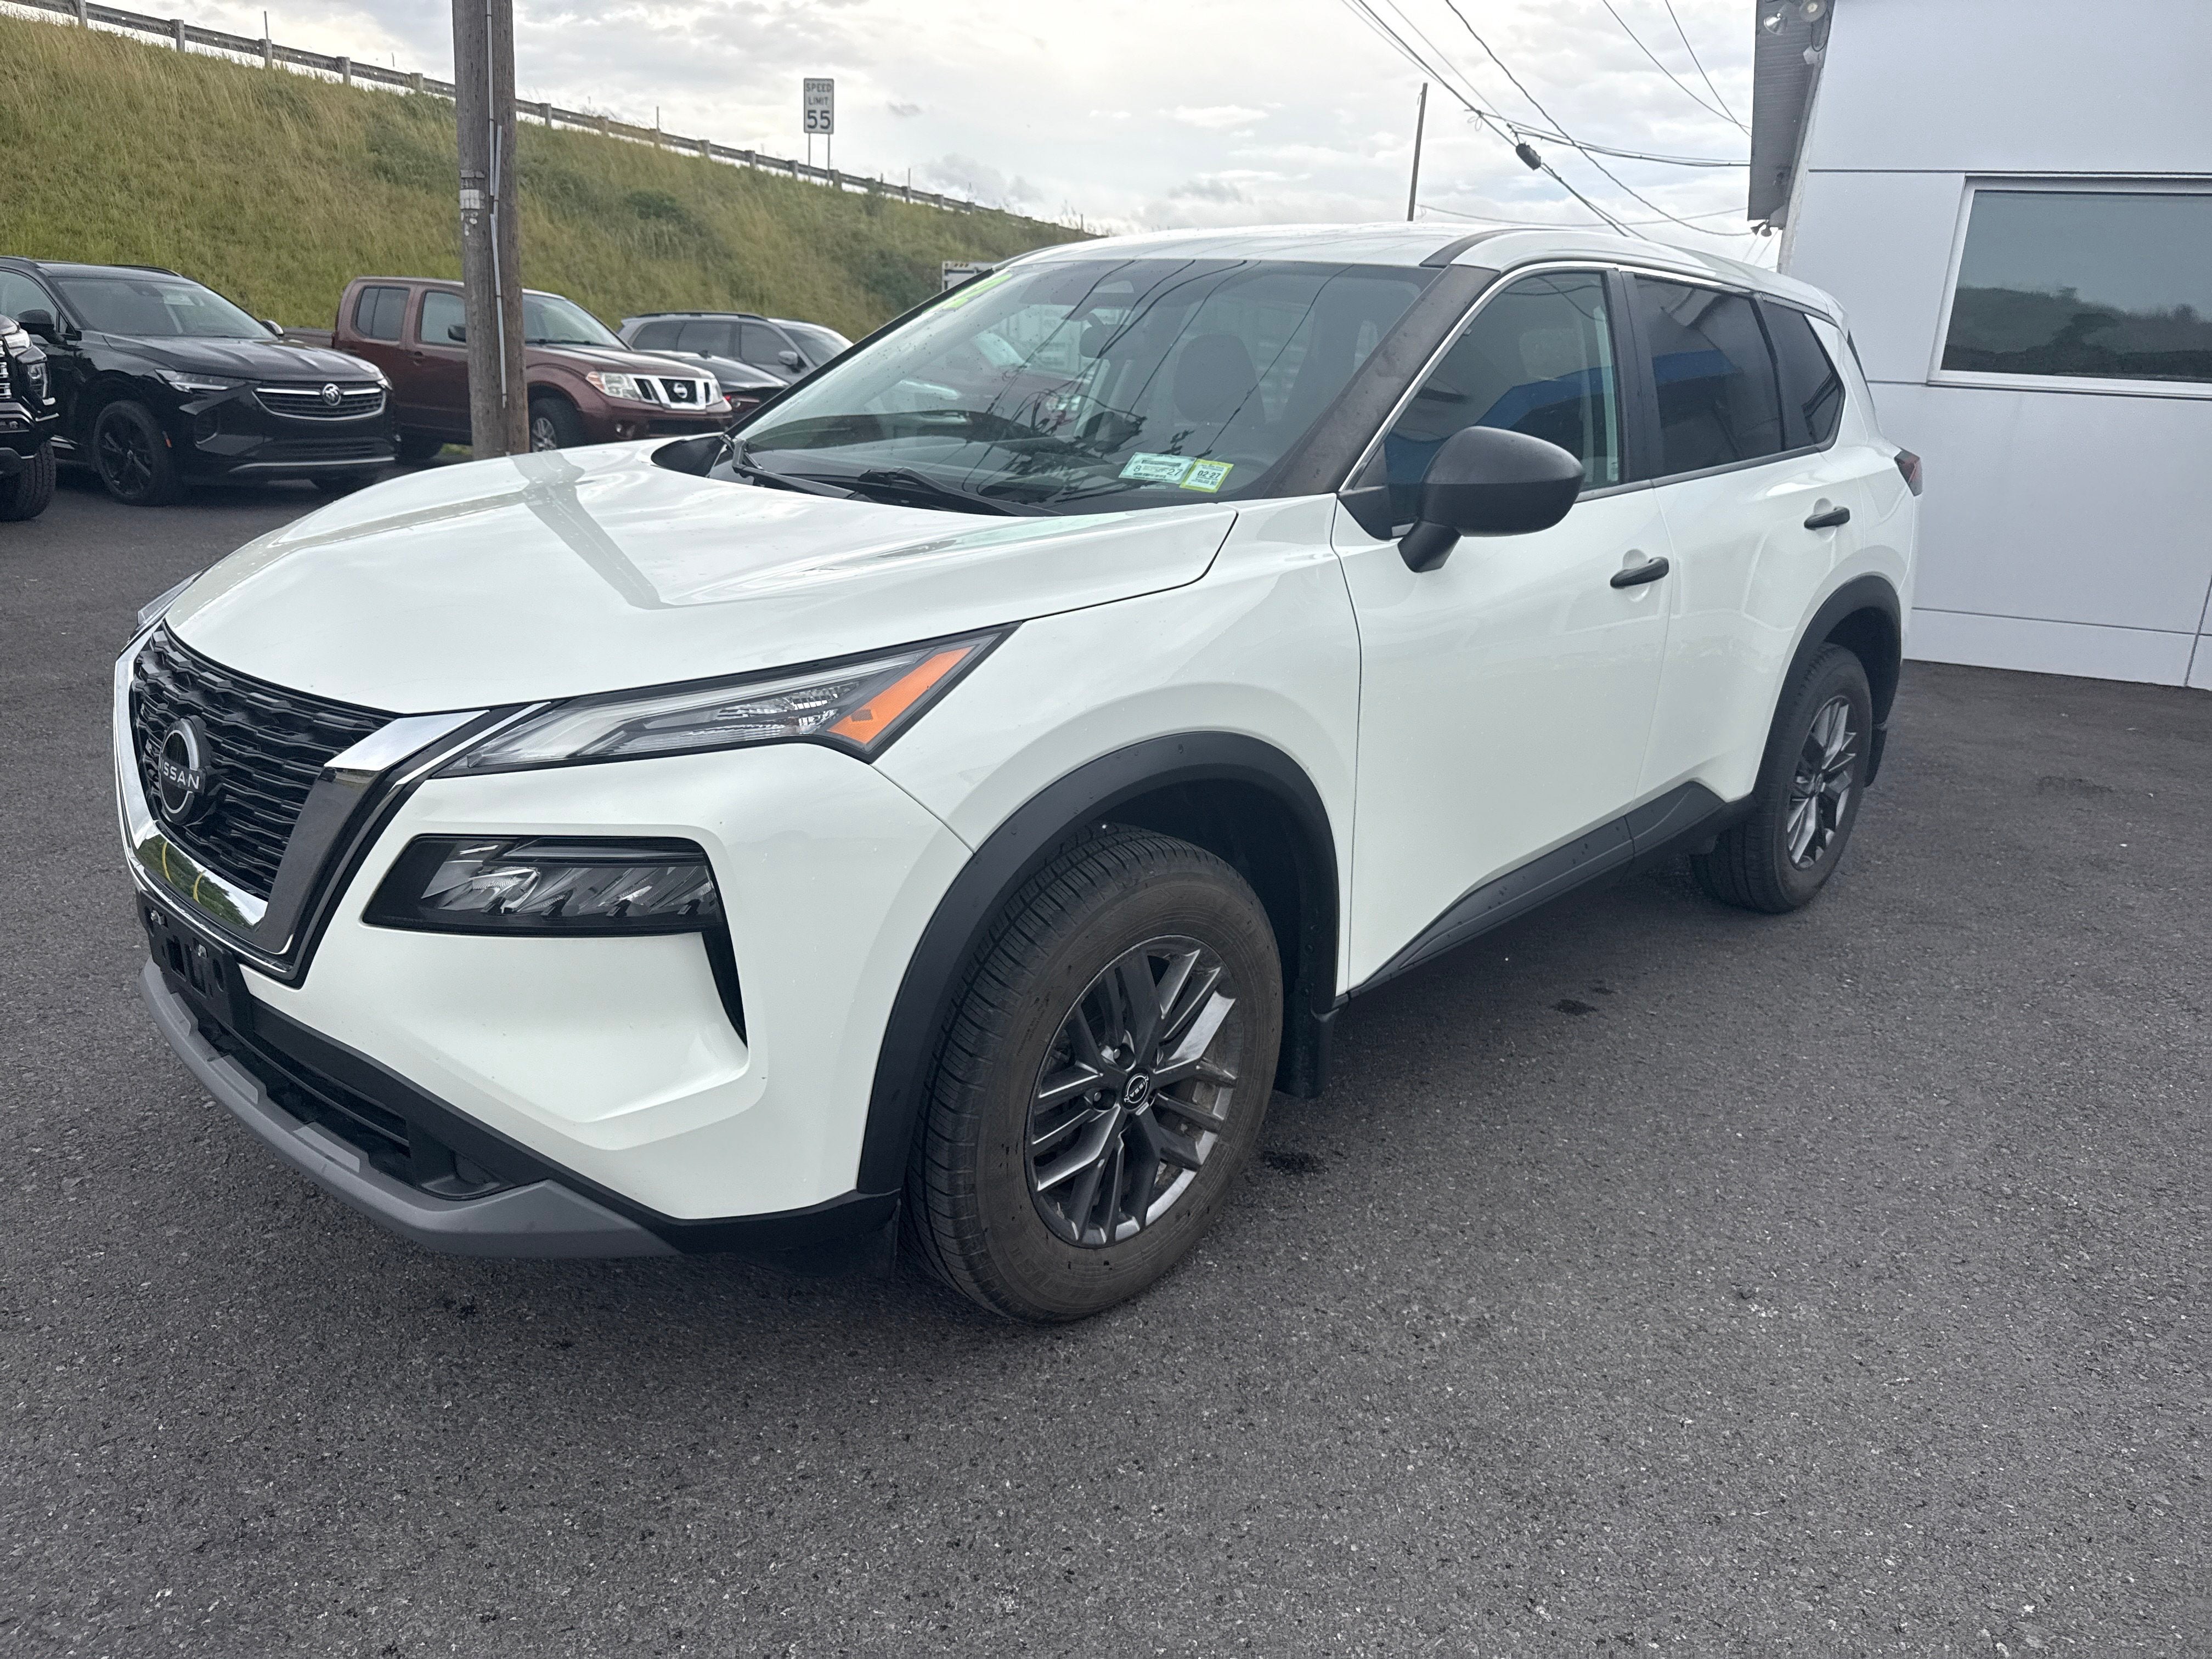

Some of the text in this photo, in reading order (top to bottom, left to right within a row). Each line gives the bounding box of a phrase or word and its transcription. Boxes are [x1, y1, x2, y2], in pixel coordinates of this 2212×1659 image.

[806, 83, 832, 92] SPEED
[808, 97, 828, 105] LIMIT
[807, 110, 831, 129] 55
[1124, 1075, 1149, 1103] NISSAN
